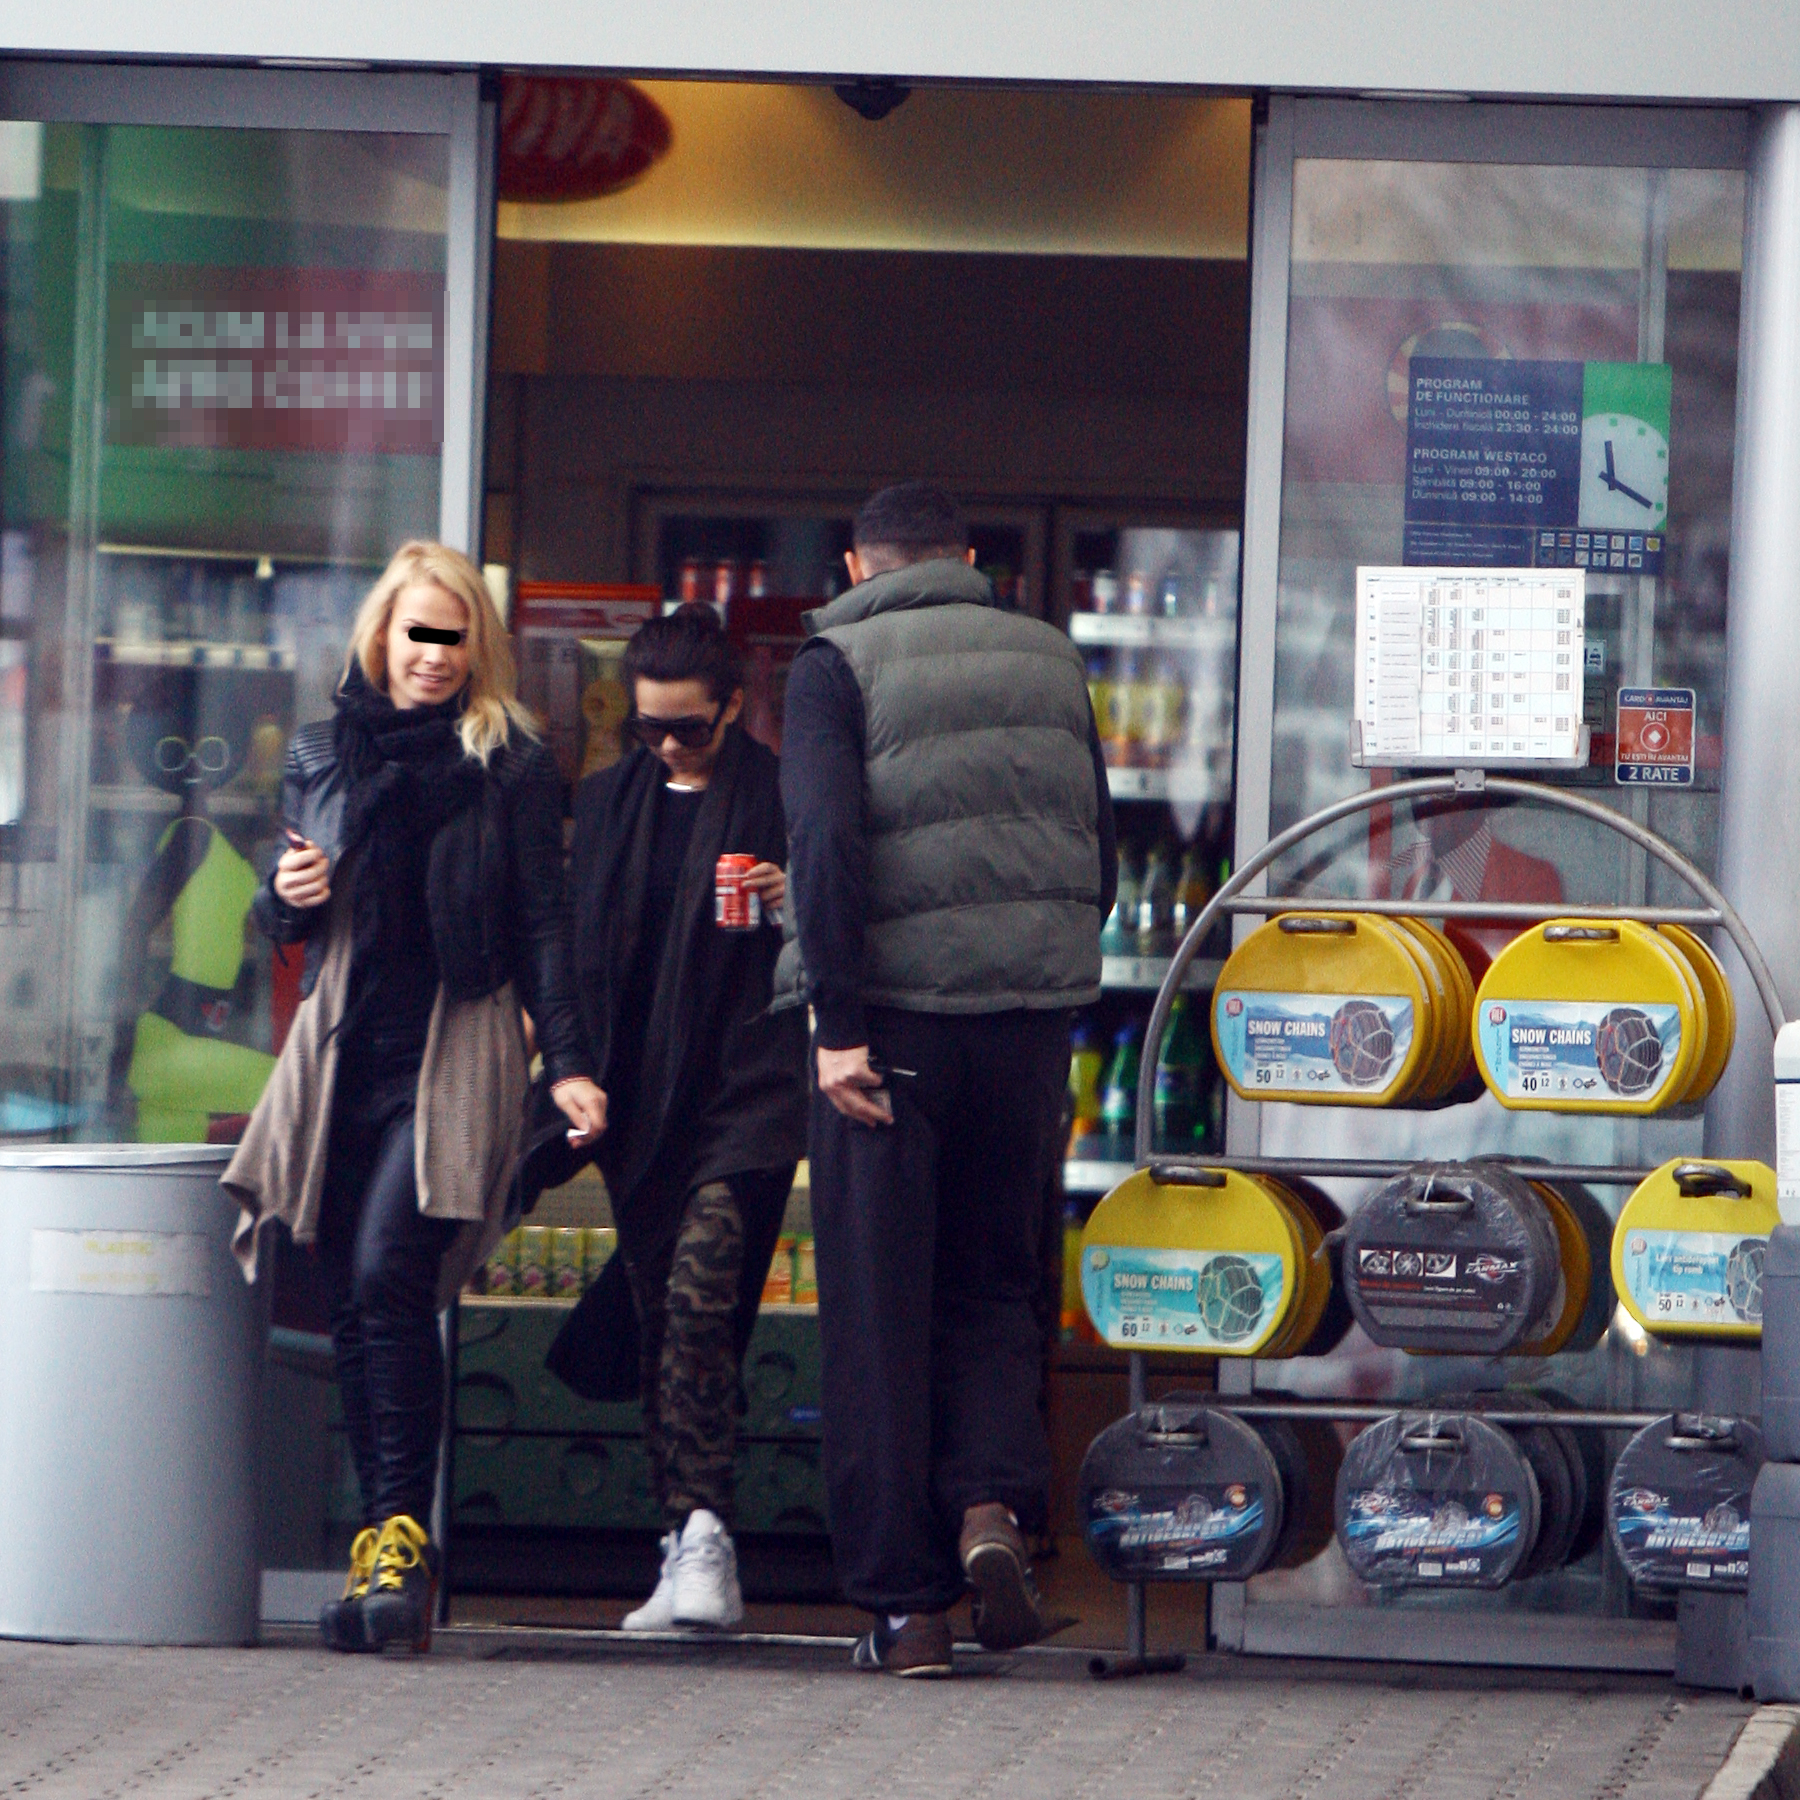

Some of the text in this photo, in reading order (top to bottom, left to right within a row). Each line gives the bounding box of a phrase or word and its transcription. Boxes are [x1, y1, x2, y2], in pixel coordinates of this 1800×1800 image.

[1416, 378, 1482, 390] PROGRAM
[1415, 391, 1433, 402] DE
[1496, 422, 1532, 433] 23:30
[1543, 424, 1579, 435] 24:00
[1413, 448, 1547, 463] PROGRAM WESTACO
[1412, 464, 1434, 474] Luni
[1474, 466, 1510, 477] 09:00
[1521, 468, 1557, 479] 20:00
[1507, 481, 1541, 491] 16:00
[1461, 491, 1497, 502] 09:00
[1509, 493, 1543, 504] 14:00
[1643, 711, 1667, 721] AICI
[1628, 766, 1680, 781] 2 RATE
[1248, 1020, 1326, 1037] SNOW CHAINS
[1511, 1028, 1592, 1045] SNOW CHAINS
[1256, 1069, 1271, 1084] 50
[1522, 1077, 1550, 1091] 40 12
[1113, 1272, 1193, 1291] SNOW CHAINS
[1659, 1298, 1672, 1311] 50
[1122, 1322, 1137, 1337] 60
